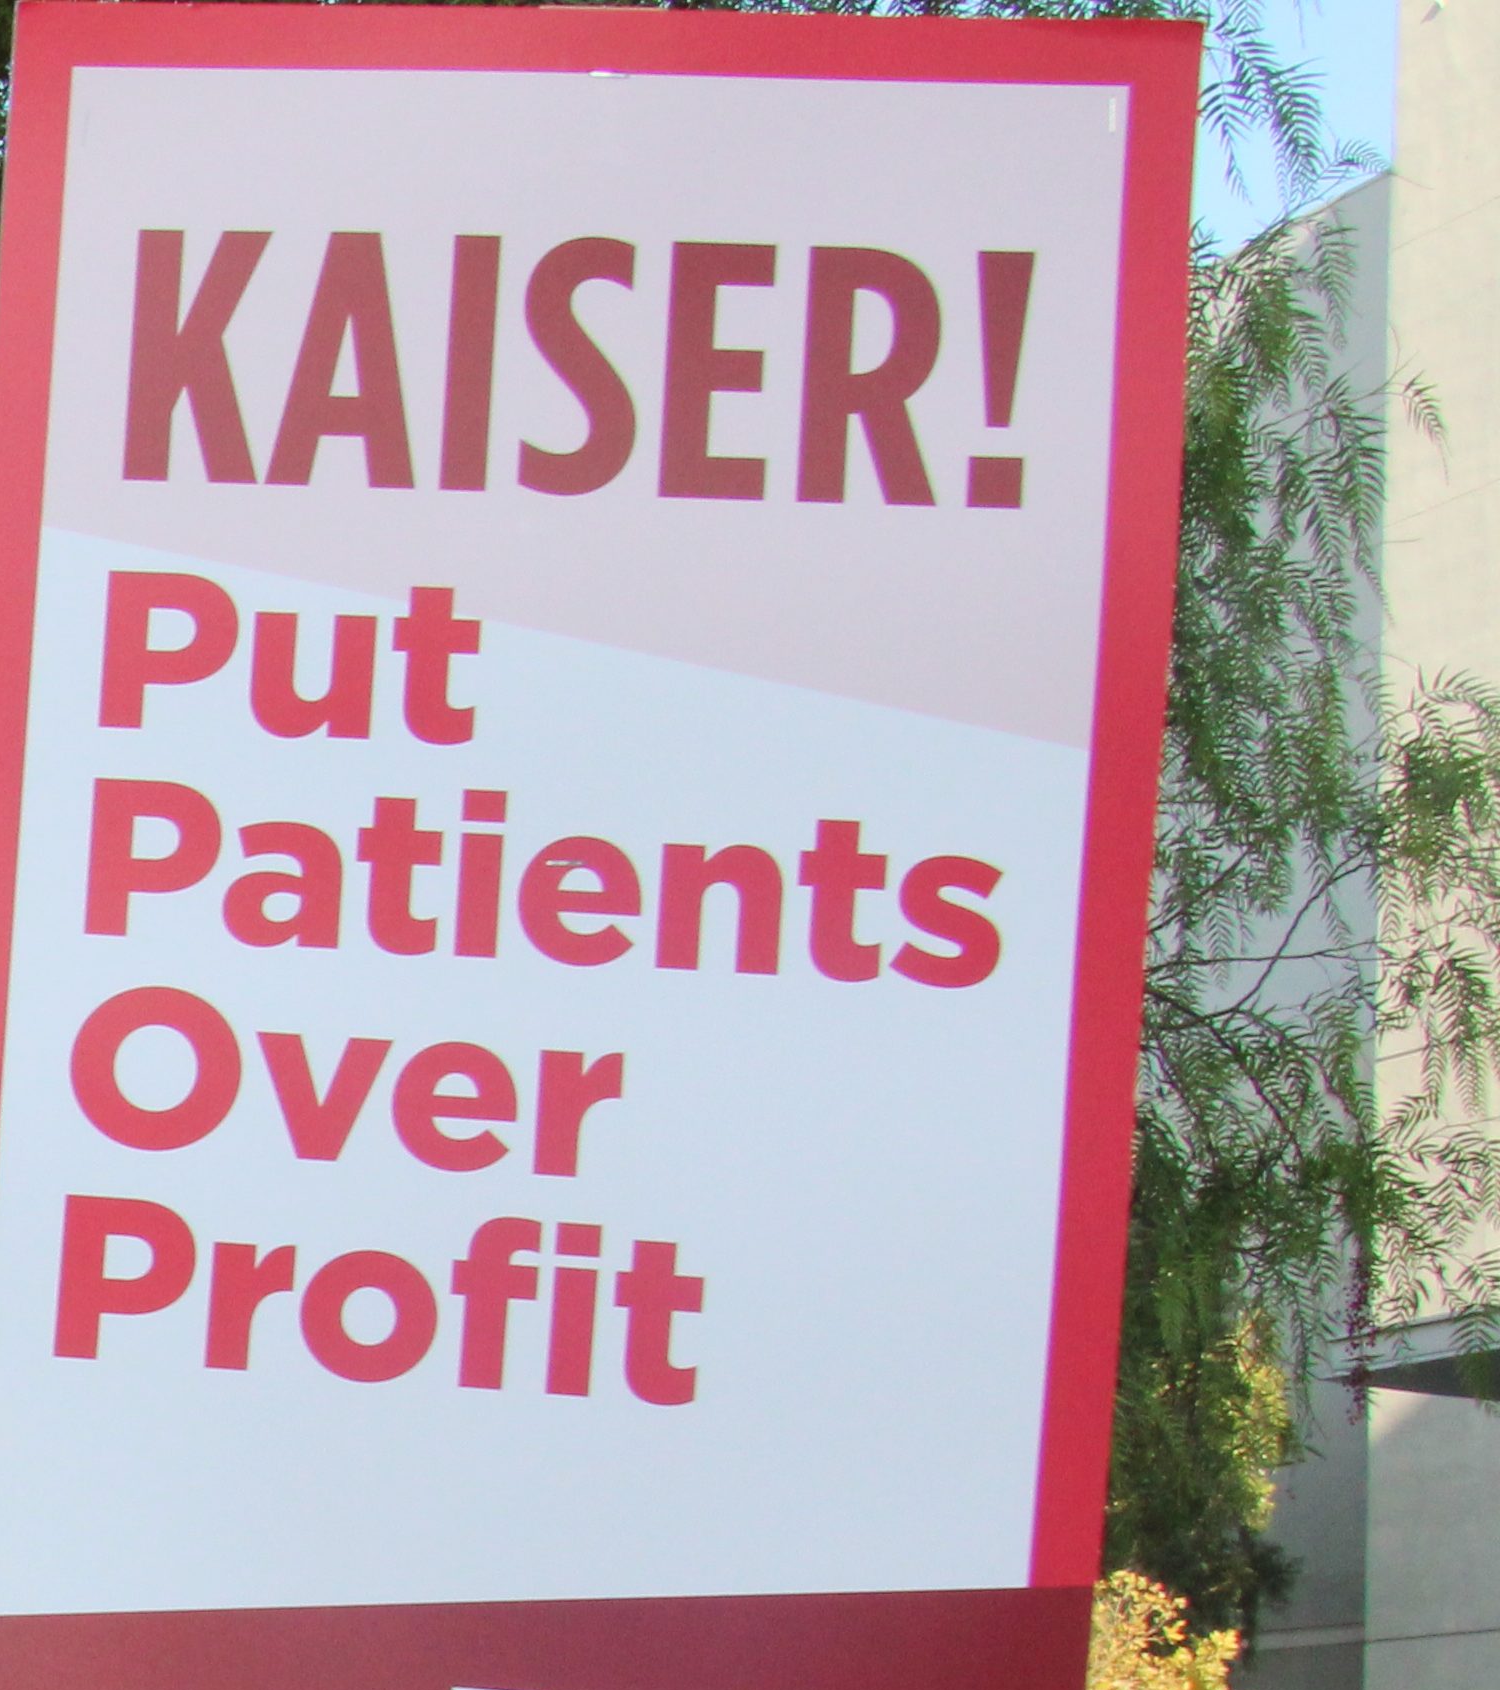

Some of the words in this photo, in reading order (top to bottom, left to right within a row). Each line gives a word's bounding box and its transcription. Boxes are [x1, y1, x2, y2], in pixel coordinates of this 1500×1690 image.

[120, 227, 1036, 512] KAISER!
[96, 568, 483, 747] Put
[82, 776, 1004, 990] Patients
[68, 985, 625, 1179] Over
[51, 1193, 706, 1409] Profit
